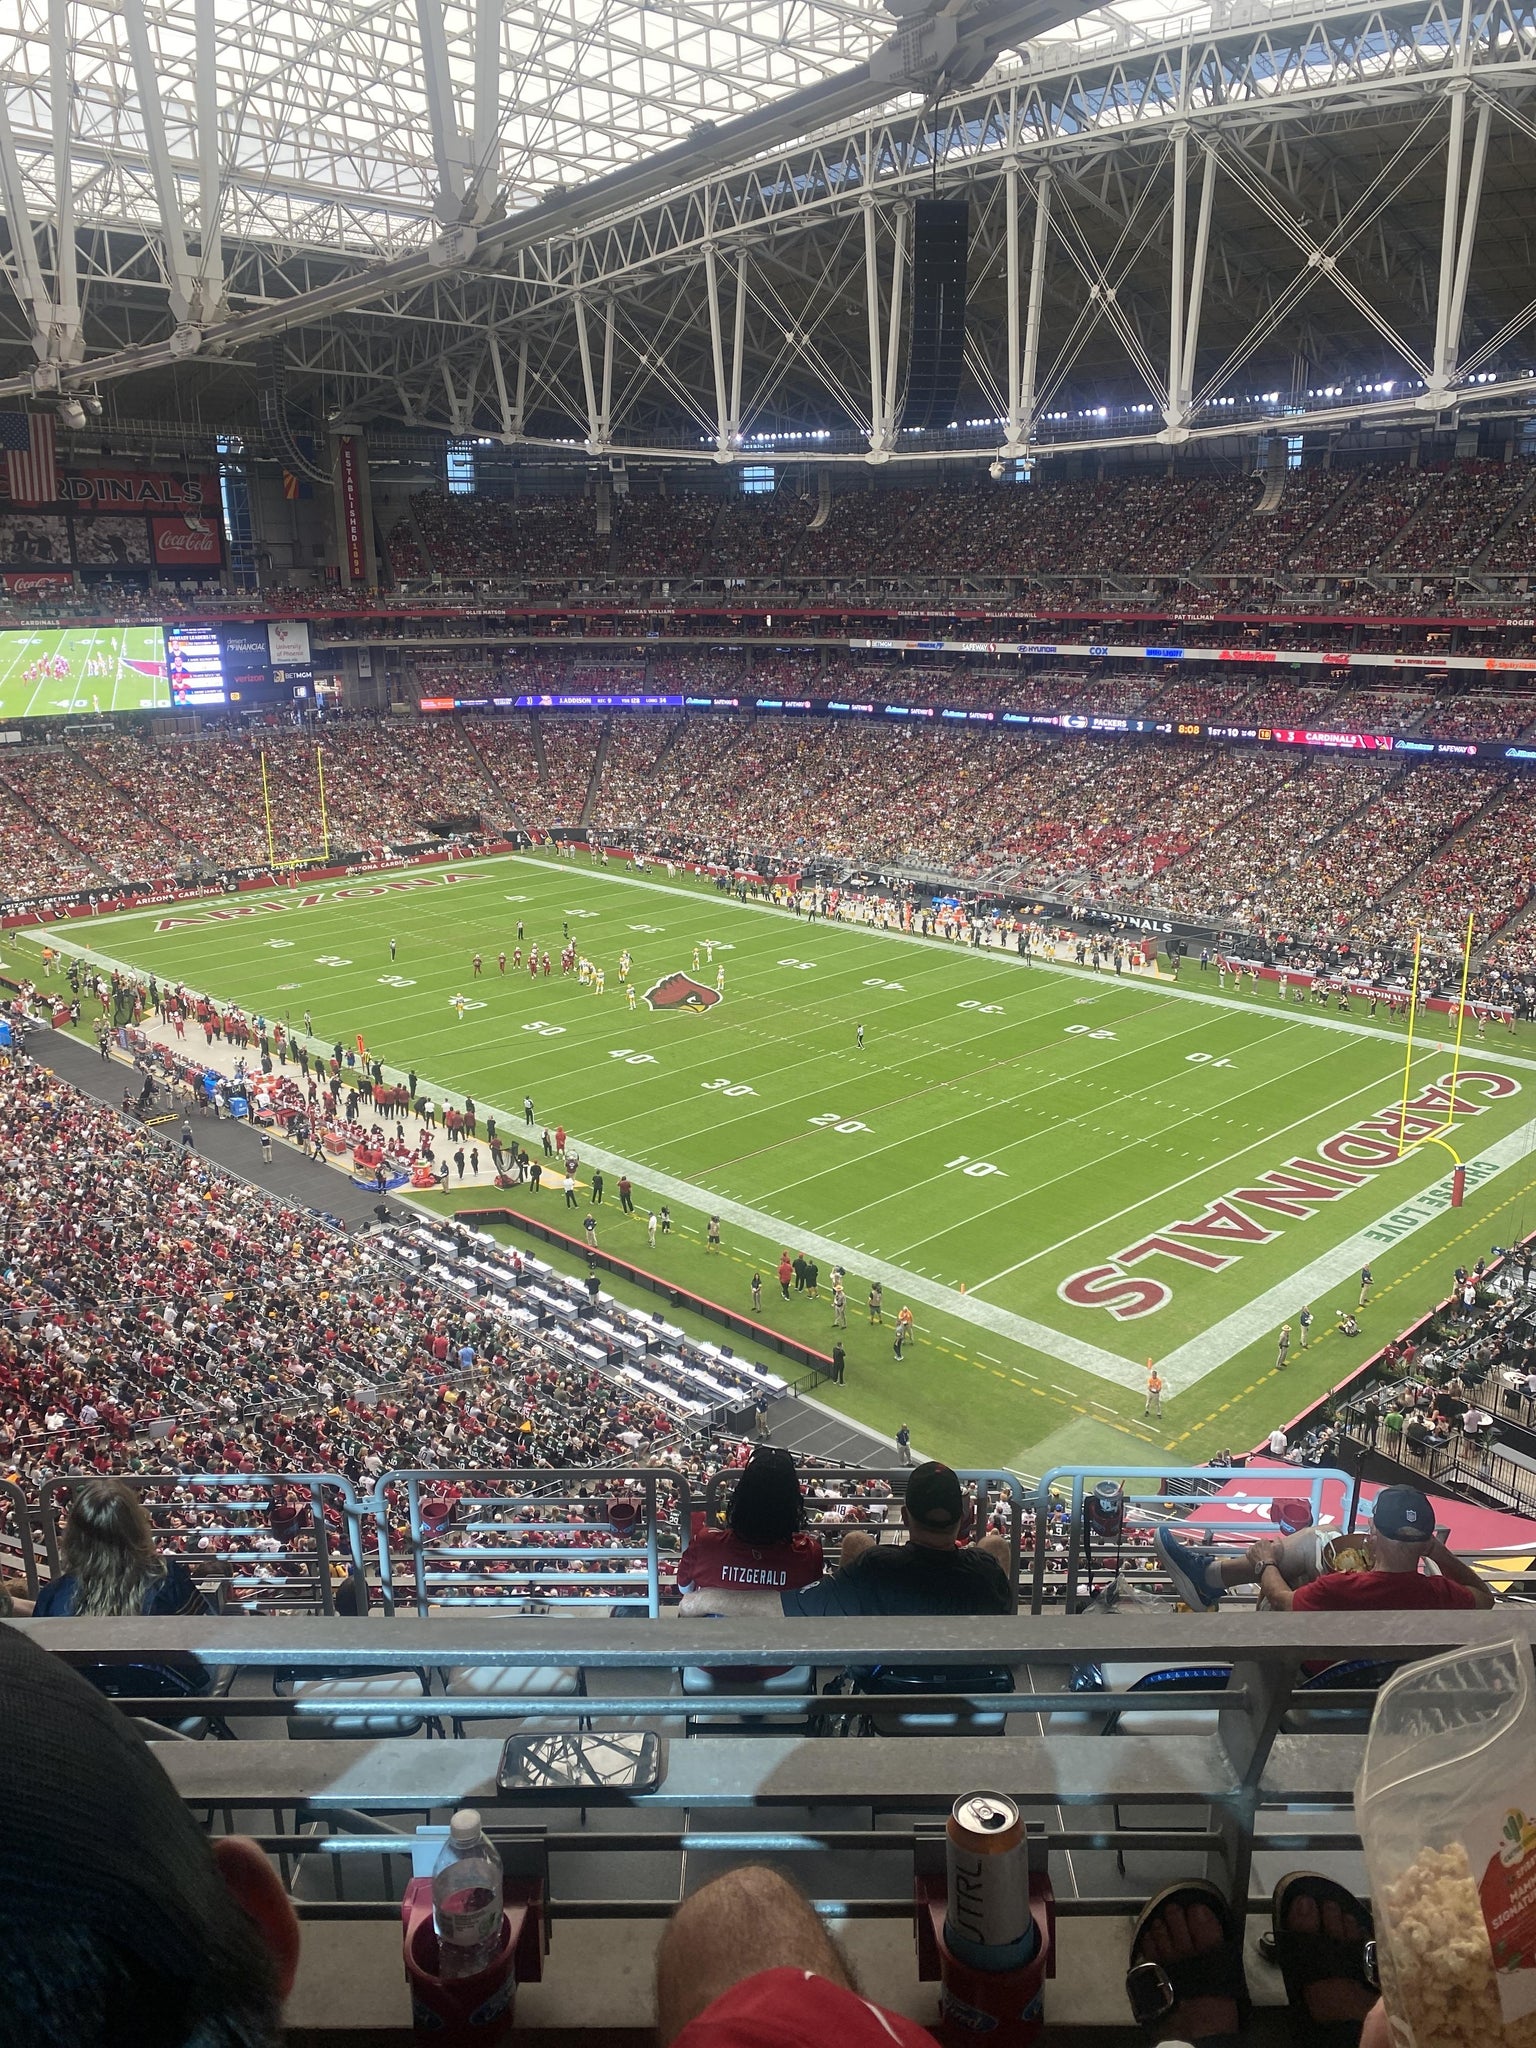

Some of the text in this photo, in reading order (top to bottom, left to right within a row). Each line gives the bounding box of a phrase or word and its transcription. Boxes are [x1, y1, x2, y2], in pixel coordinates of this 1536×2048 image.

[345, 451, 358, 541] ESTABLISHED
[158, 529, 214, 551] Coca-Cola
[961, 643, 987, 651] SAFEWAY
[1089, 646, 1109, 656] COX
[234, 674, 264, 683] verizon
[285, 671, 312, 680] BETMGM
[1093, 718, 1128, 728] PACKERS
[1136, 721, 1144, 731] 3
[1177, 725, 1200, 735] 8:08
[1227, 727, 1239, 737] 10
[1287, 731, 1295, 742] 3
[1305, 732, 1357, 744] CARDINALS
[1438, 744, 1468, 753] SAFEWAY
[153, 872, 496, 934] ARIZONA
[313, 954, 354, 967] 20
[376, 973, 418, 988] 30
[521, 1019, 567, 1037] 50
[607, 1048, 654, 1066] 40
[700, 1077, 754, 1098] 30
[807, 1112, 867, 1134] 20
[943, 1154, 999, 1178] 10
[1055, 1070, 1523, 1322] CARDINALS
[1363, 1206, 1432, 1244] LOVE
[721, 1565, 787, 1586] FITZGERALD
